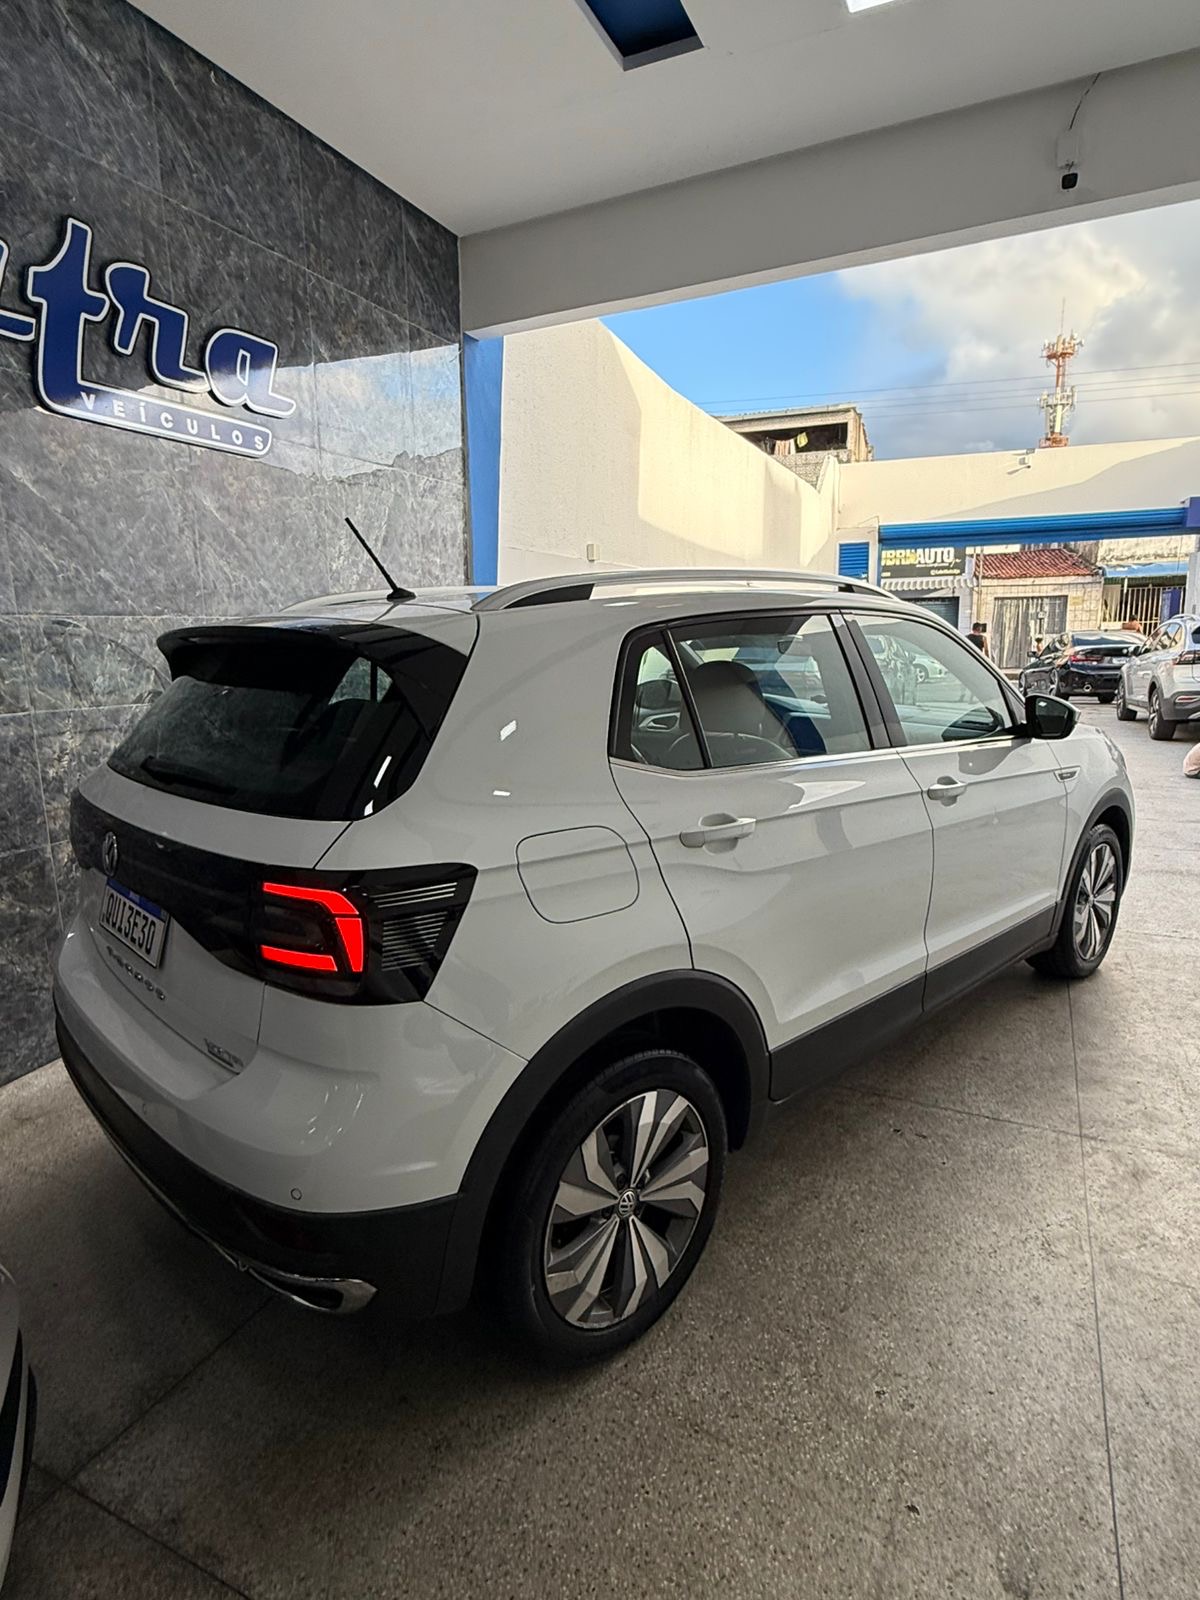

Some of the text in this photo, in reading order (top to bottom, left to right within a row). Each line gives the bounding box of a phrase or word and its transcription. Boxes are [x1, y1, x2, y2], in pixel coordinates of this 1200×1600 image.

[0, 217, 296, 417] tra
[80, 391, 264, 451] VEÍCULOS
[105, 893, 156, 955] QUI3E30
